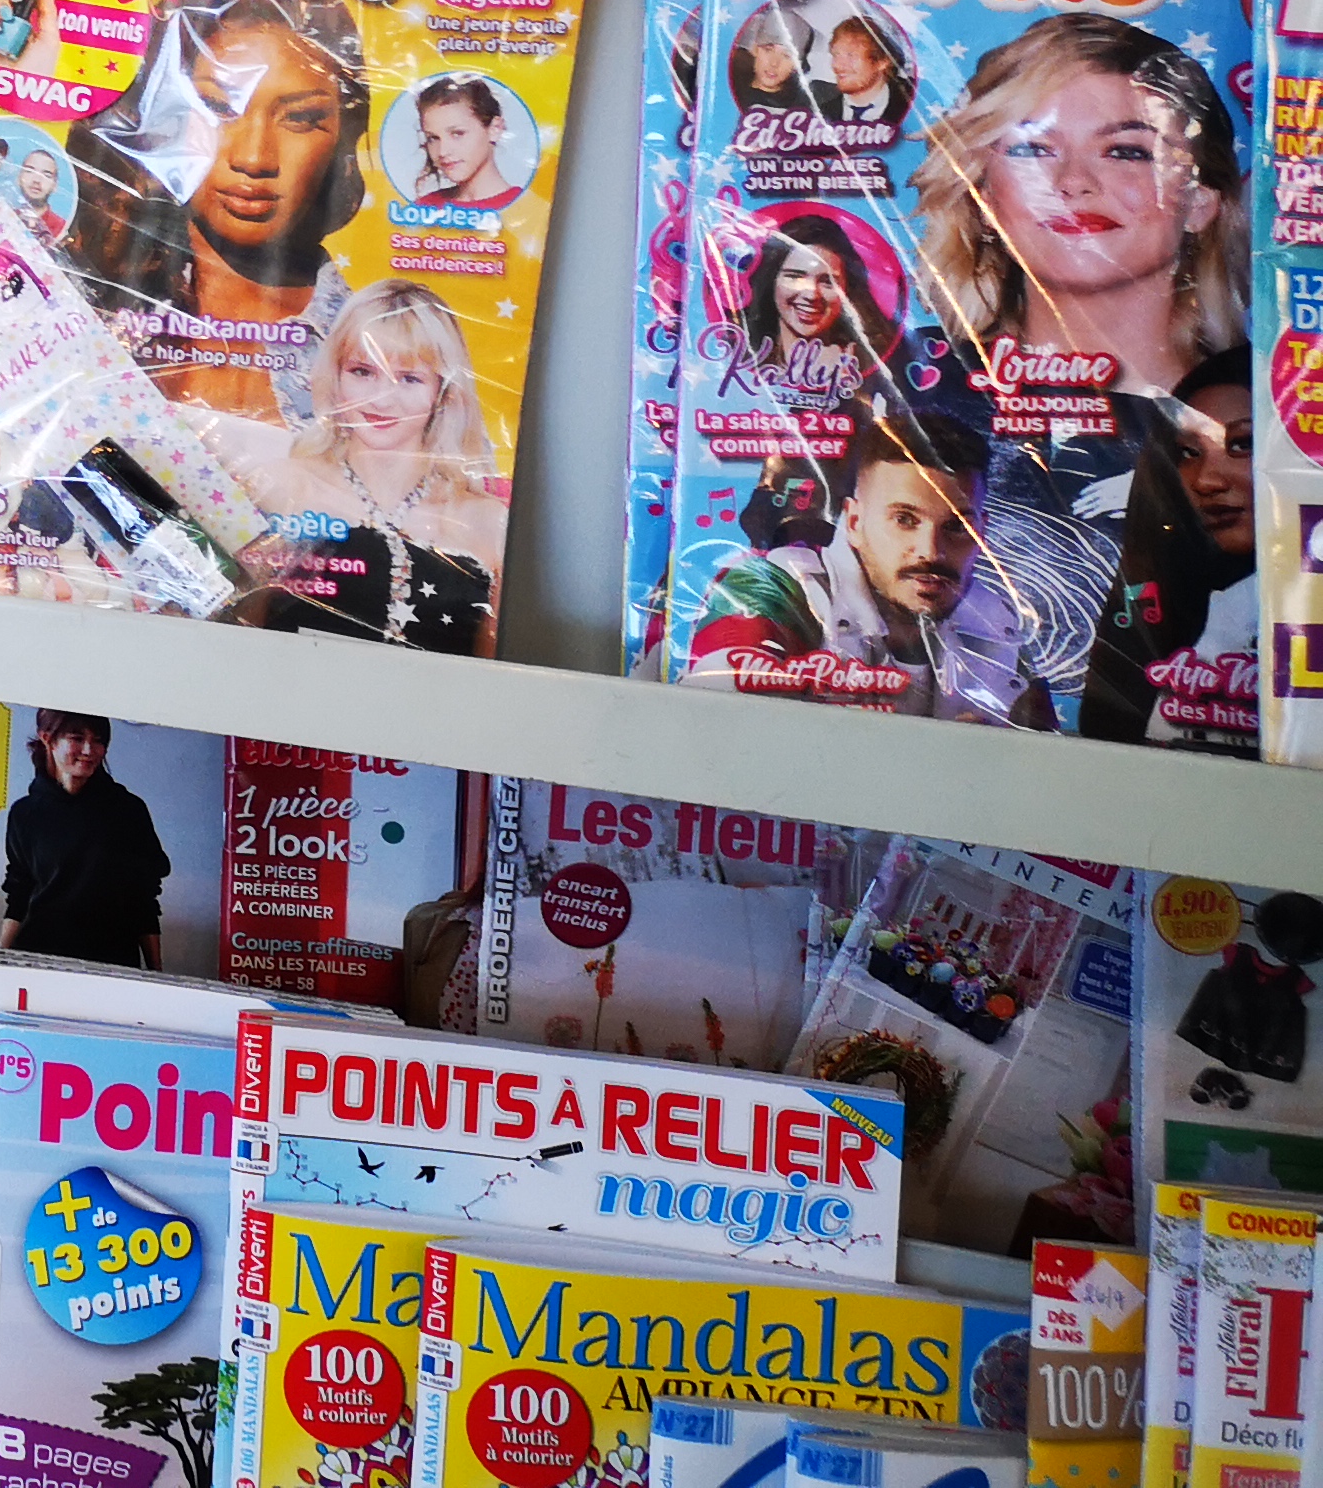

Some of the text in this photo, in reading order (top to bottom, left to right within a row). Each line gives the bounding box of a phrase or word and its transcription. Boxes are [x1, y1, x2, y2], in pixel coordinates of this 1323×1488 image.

[427, 15, 566, 35] Une jeune étoile
[745, 173, 888, 192] JUSTIN BIEBER
[390, 233, 505, 255] Ses dernières
[168, 311, 306, 346] Nakamura
[997, 396, 1108, 414] TOUJOURS
[697, 412, 851, 435] La saison 2 va
[236, 788, 360, 822] 1 pièce
[236, 824, 367, 864] 2 looks
[234, 880, 319, 900] PRÉFÉRÉES
[556, 876, 619, 900] encart
[542, 891, 628, 919] transfert
[281, 1048, 875, 1190] POINTS À RELIER
[598, 1170, 851, 1244] magic
[28, 1221, 192, 1287] 13 300
[70, 1276, 182, 1329] points
[1047, 1308, 1078, 1328] DÈS
[471, 1269, 951, 1398] Mandalas
[305, 1344, 384, 1385] 100
[1222, 1421, 1280, 1448] Déco
